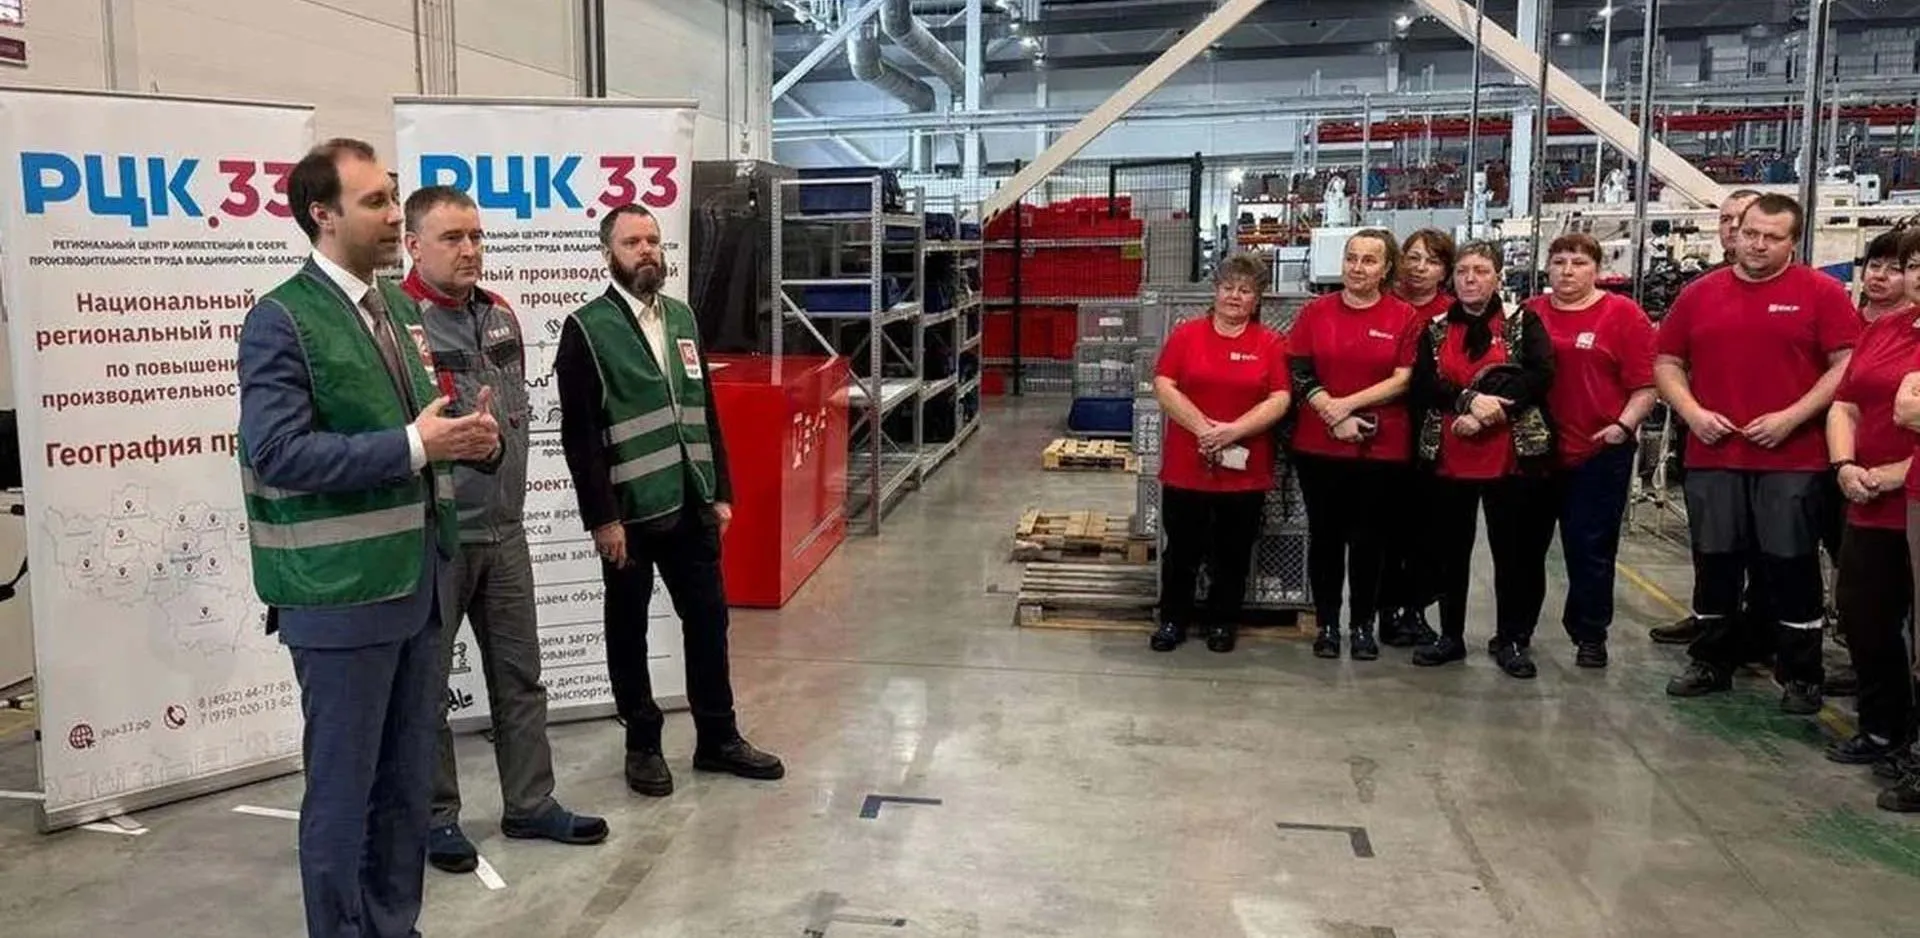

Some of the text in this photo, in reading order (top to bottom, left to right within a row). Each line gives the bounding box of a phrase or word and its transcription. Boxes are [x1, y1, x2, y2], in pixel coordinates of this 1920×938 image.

[19, 151, 294, 228] РЦК.33
[420, 155, 678, 219] РЦК.33
[52, 240, 287, 251] РЕГИОНАЛЬНЫЙ ЦЕНТР КОМПЕТЕНЦИЙ В СФЕРЕ
[522, 231, 549, 240] ЦЕНТР
[29, 256, 151, 266] ПРОИЗВОДИТЕЛЬНОСТИ
[154, 256, 182, 266] ТРУДА
[186, 254, 266, 265] ВЛАДИМИРСКОЙ
[534, 244, 561, 253] ТРУДА
[76, 289, 255, 314] Национальный
[521, 291, 588, 305] процесс
[36, 321, 212, 351] региональный
[106, 363, 129, 377] по
[46, 434, 201, 468] География
[209, 691, 242, 709] (4922)
[245, 681, 293, 699] 44-77-85
[209, 706, 237, 724] (919)
[240, 696, 294, 717] 020-13-62
